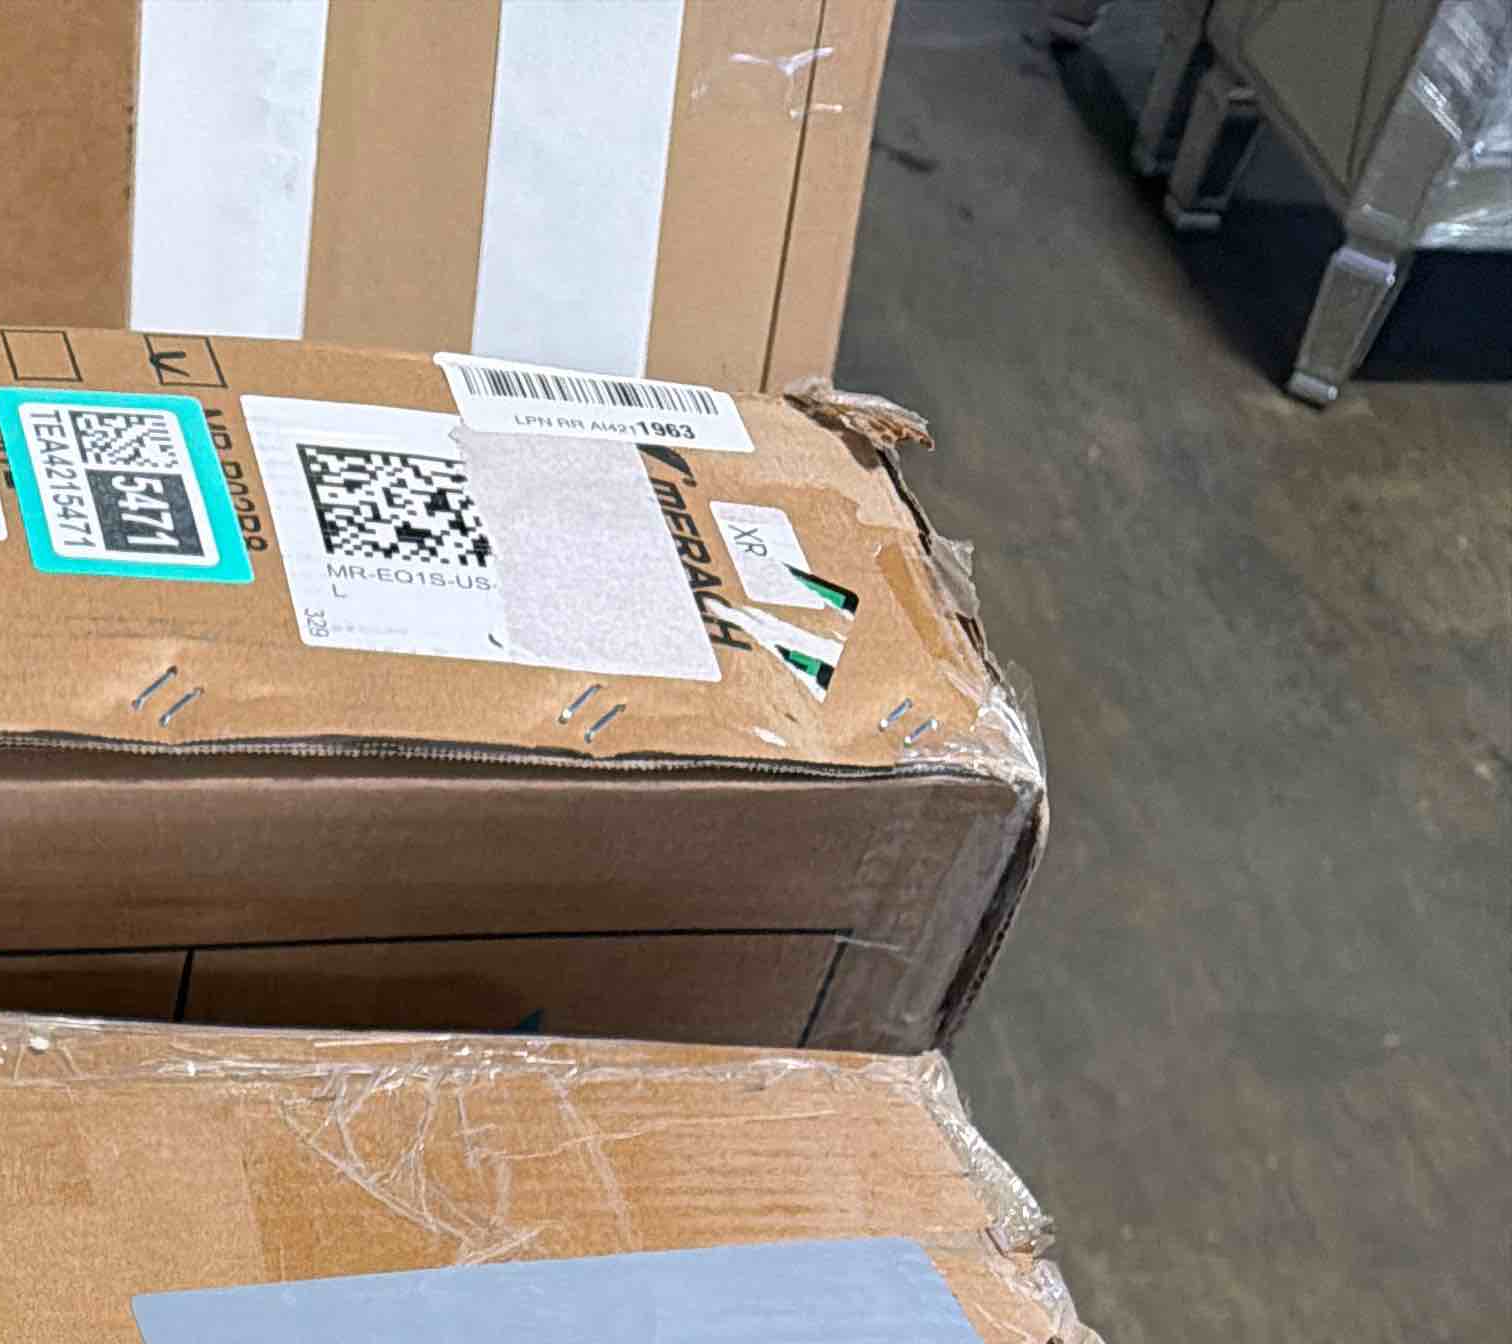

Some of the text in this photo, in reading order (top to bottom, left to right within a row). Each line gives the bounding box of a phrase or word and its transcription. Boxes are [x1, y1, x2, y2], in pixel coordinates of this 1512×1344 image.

[513, 414, 554, 429] LPN
[30, 408, 97, 550] TEA4215471
[110, 473, 182, 548] 5471
[726, 524, 769, 559] XR
[332, 584, 348, 600] L
